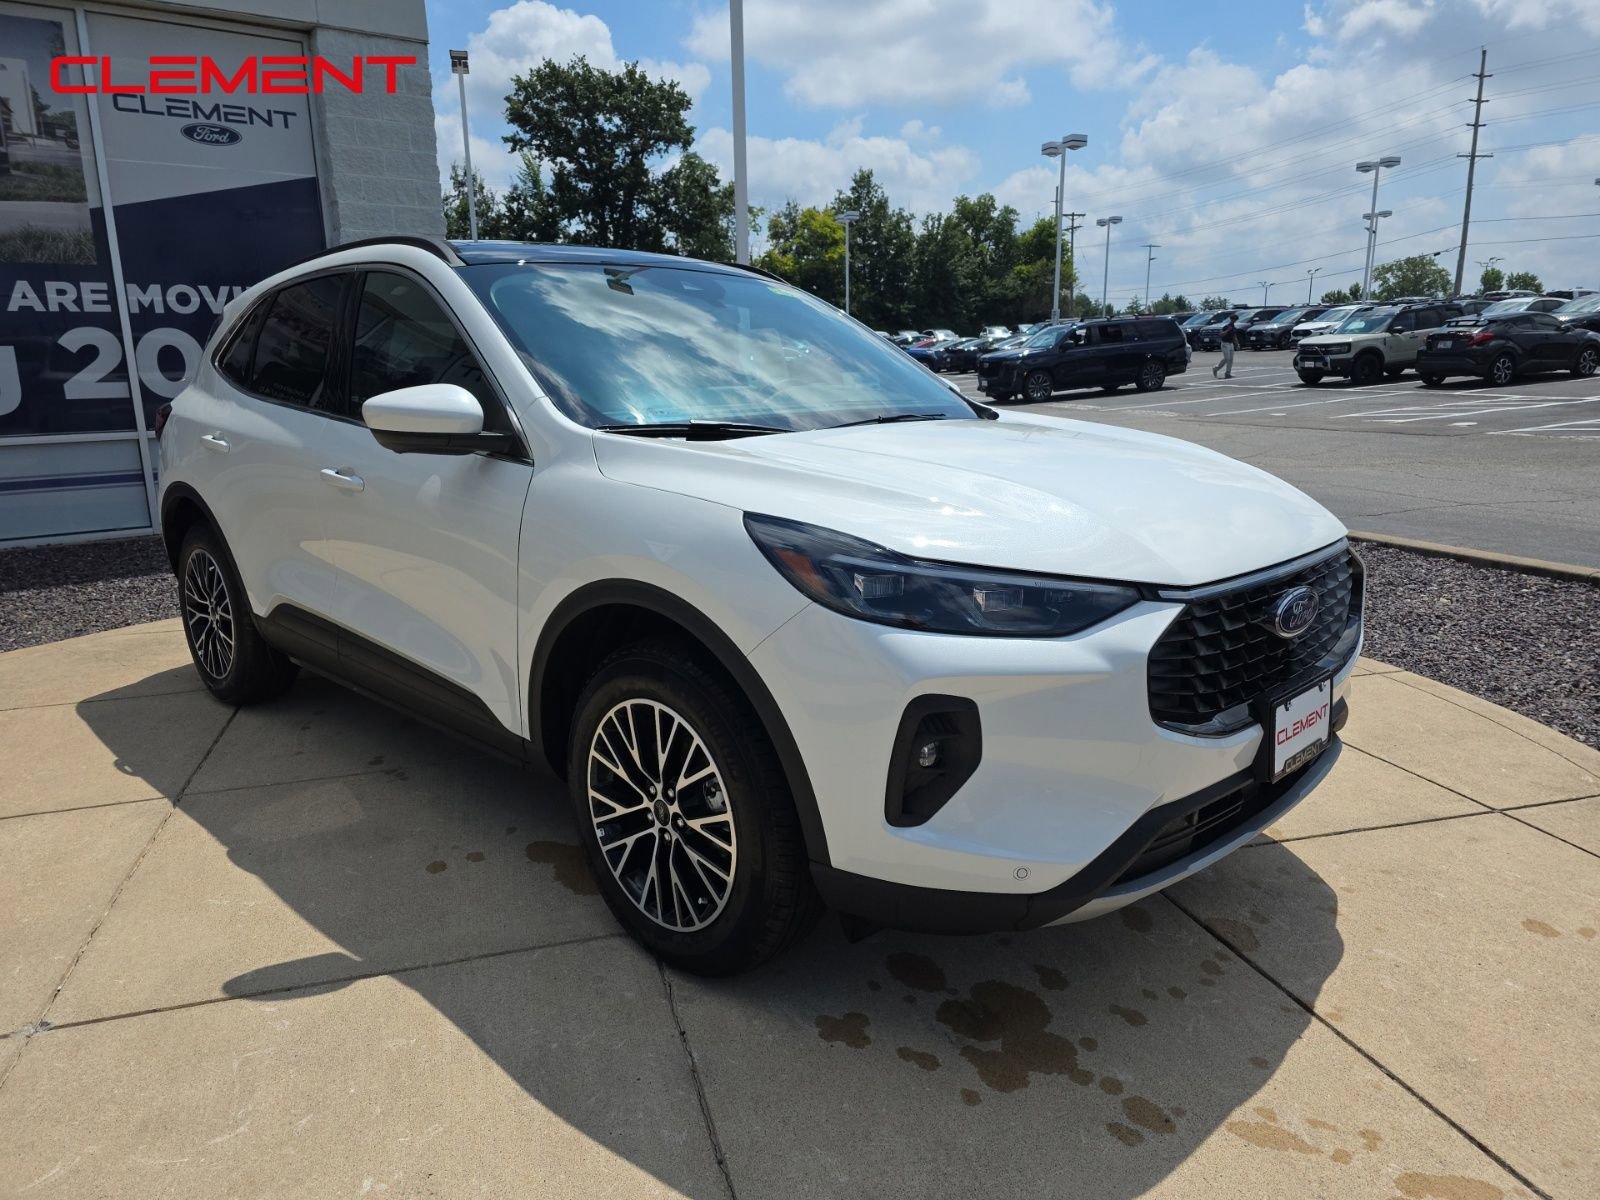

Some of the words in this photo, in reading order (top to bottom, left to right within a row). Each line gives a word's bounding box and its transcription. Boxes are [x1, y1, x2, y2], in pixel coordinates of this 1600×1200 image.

[112, 92, 297, 129] CLEMENT
[193, 125, 231, 144] Ford
[7, 280, 112, 312] ARE
[126, 283, 250, 315] MOV
[1277, 703, 1329, 746] CLEMENT
[1286, 742, 1321, 772] CLEMENT
